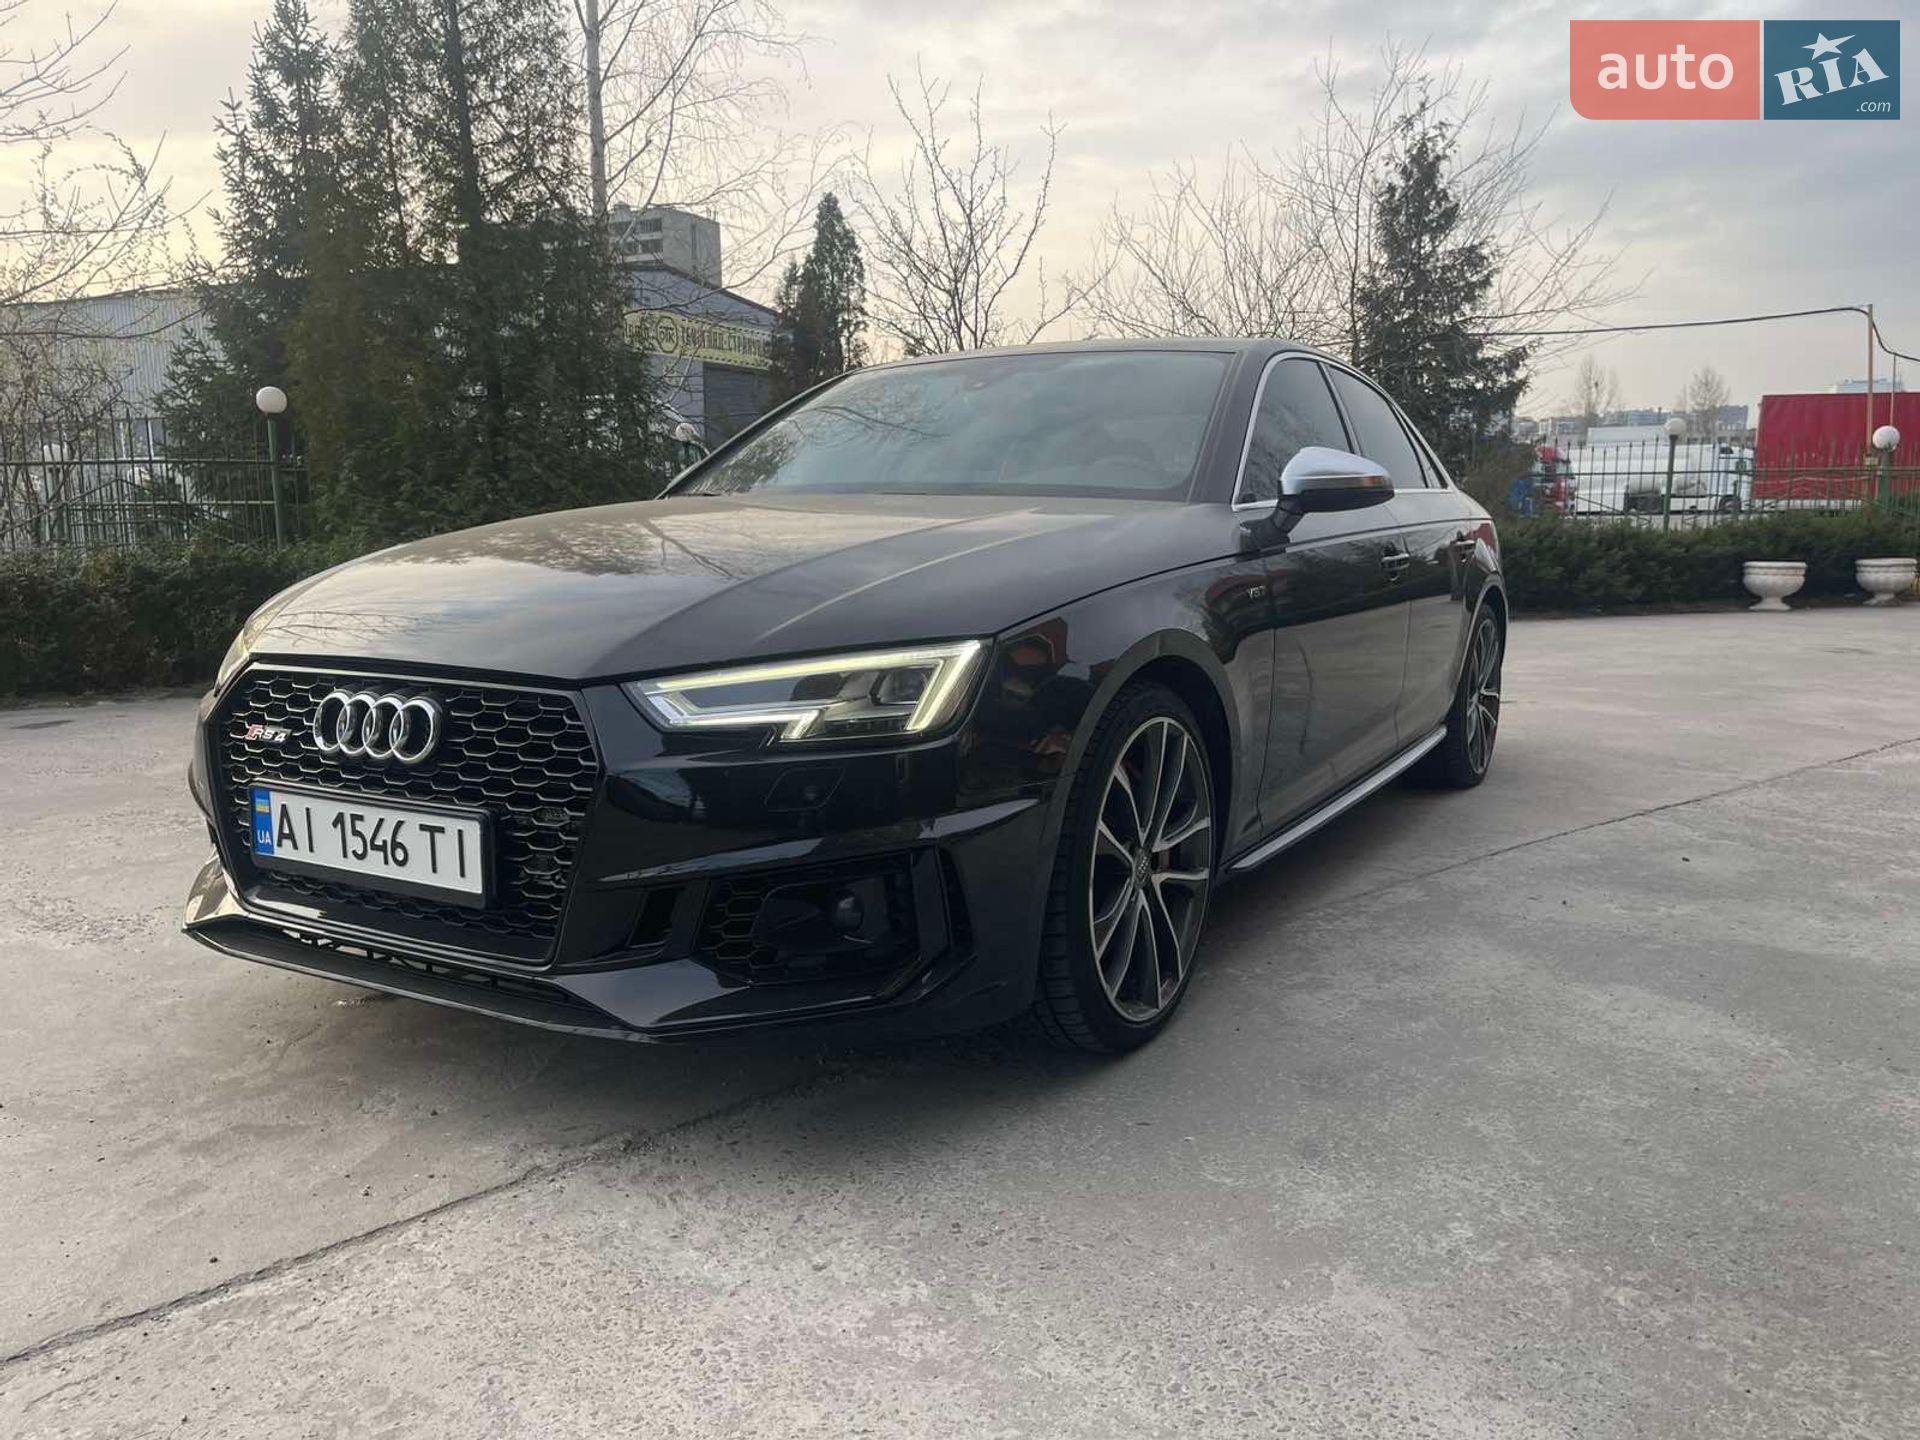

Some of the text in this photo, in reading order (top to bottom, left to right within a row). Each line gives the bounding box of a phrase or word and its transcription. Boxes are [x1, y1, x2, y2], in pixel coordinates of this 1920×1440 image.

[257, 830, 272, 844] UA
[276, 803, 465, 878] AI 1546 TI
